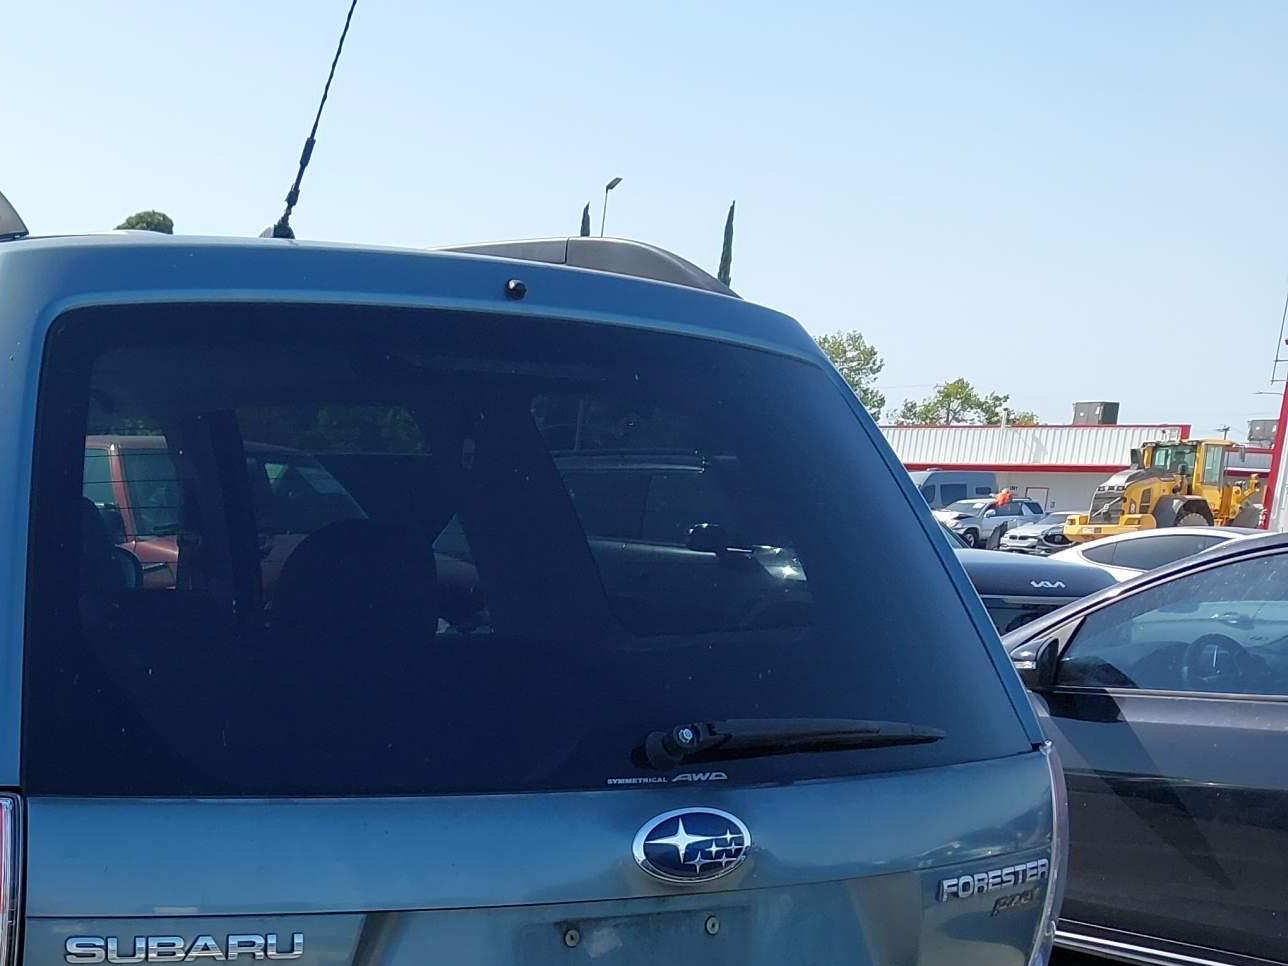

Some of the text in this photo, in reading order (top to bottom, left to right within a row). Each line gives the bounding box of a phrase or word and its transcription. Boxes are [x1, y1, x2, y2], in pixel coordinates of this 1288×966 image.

[607, 772, 729, 785] SYMMETRICAL AWD
[938, 858, 1049, 903] FORESTER
[64, 933, 305, 964] SUBARU
